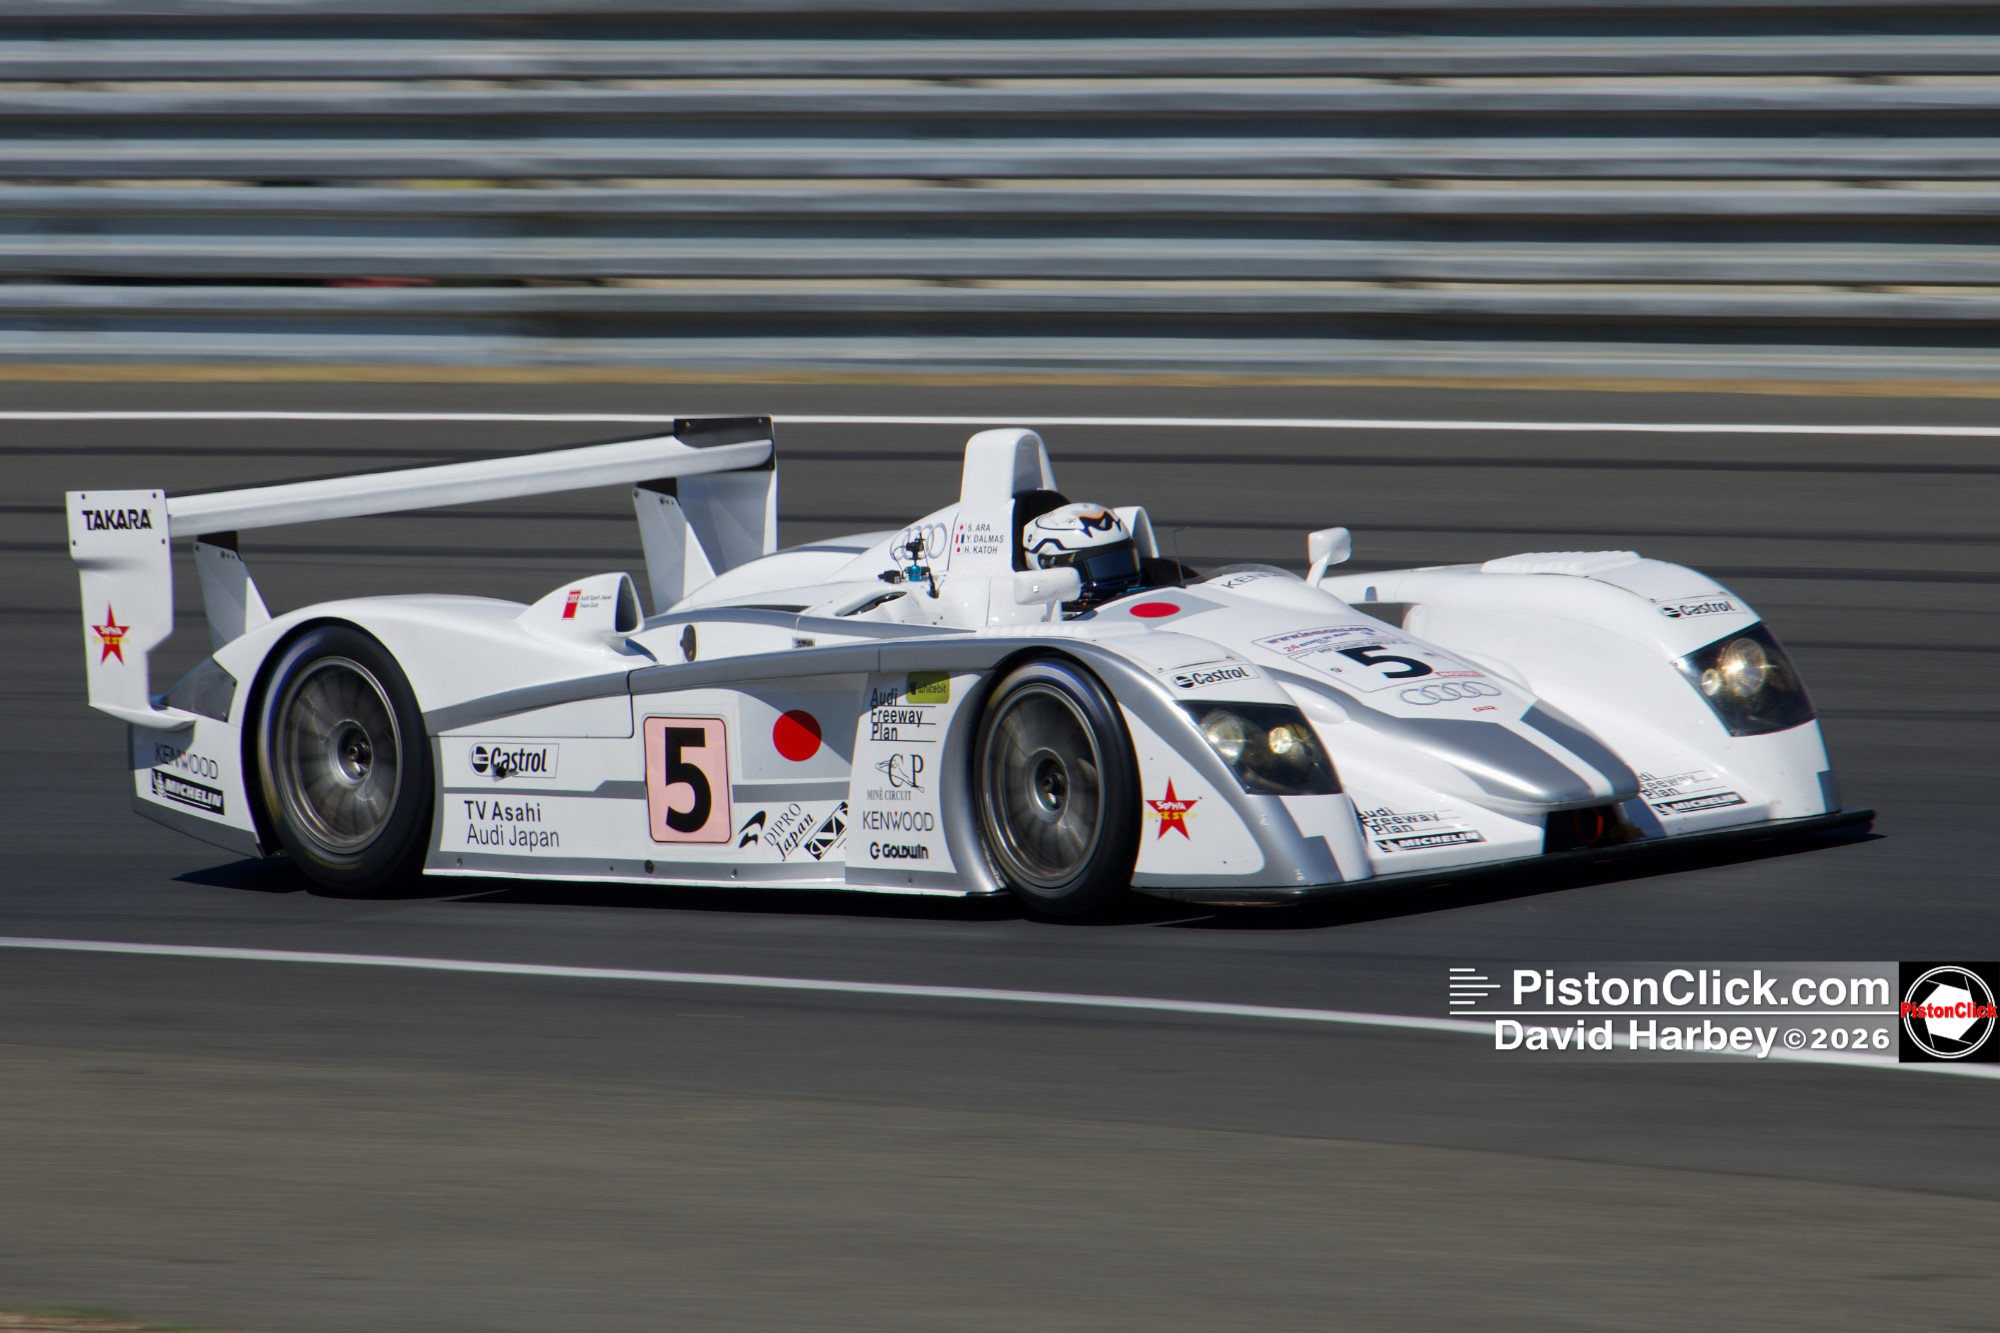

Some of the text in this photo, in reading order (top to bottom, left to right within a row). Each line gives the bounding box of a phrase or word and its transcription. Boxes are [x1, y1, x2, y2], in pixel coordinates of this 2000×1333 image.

[81, 509, 152, 530] TAKARA
[975, 523, 991, 531] ARA
[973, 534, 1004, 543] DALMAS
[973, 546, 998, 554] KATOH
[1678, 600, 1737, 616] Castrol
[1336, 645, 1434, 679] 5
[1192, 666, 1250, 684] Castrol
[871, 687, 898, 707] Audi
[871, 706, 923, 728] Freeway
[872, 722, 898, 741] Plan
[155, 742, 219, 780] KENWOOD
[490, 746, 548, 774] Castrol
[664, 726, 713, 834] 5
[165, 777, 223, 808] MICHELIN
[884, 789, 912, 801] CIRCUIT
[1670, 792, 1741, 810] MICHELIN
[463, 800, 542, 822] TV Asahi
[862, 810, 935, 832] KENWOOD
[764, 802, 801, 847] DIPRO
[1371, 824, 1415, 836] Plan
[466, 823, 560, 852] Audi Japan
[776, 813, 815, 863] Japan
[1398, 831, 1480, 848] MICHELIN
